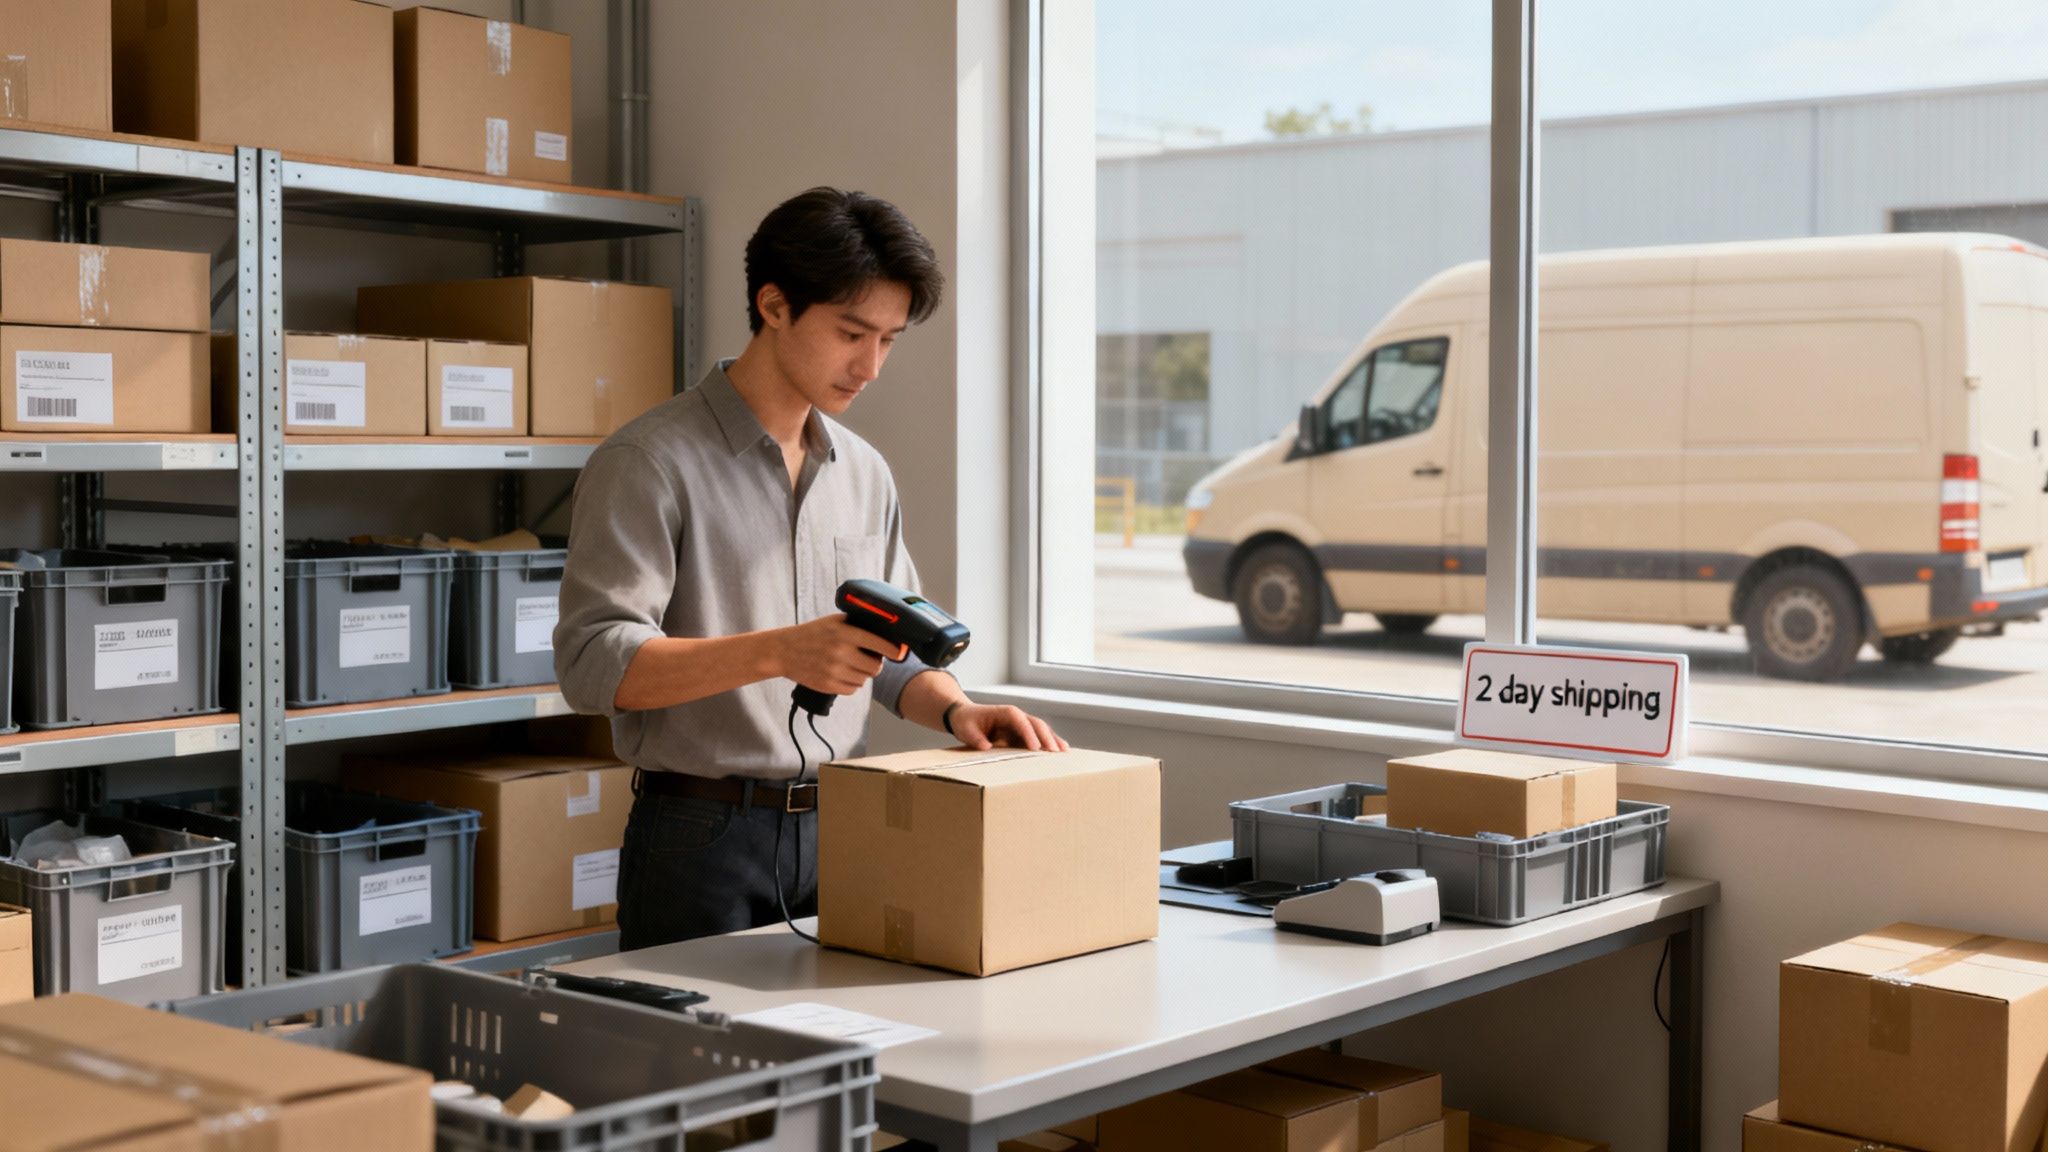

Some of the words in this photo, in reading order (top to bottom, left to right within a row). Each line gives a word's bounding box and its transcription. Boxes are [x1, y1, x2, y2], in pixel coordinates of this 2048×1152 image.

[1476, 675, 1491, 701] 2
[1499, 674, 1544, 713] day
[1552, 679, 1660, 720] shipping
